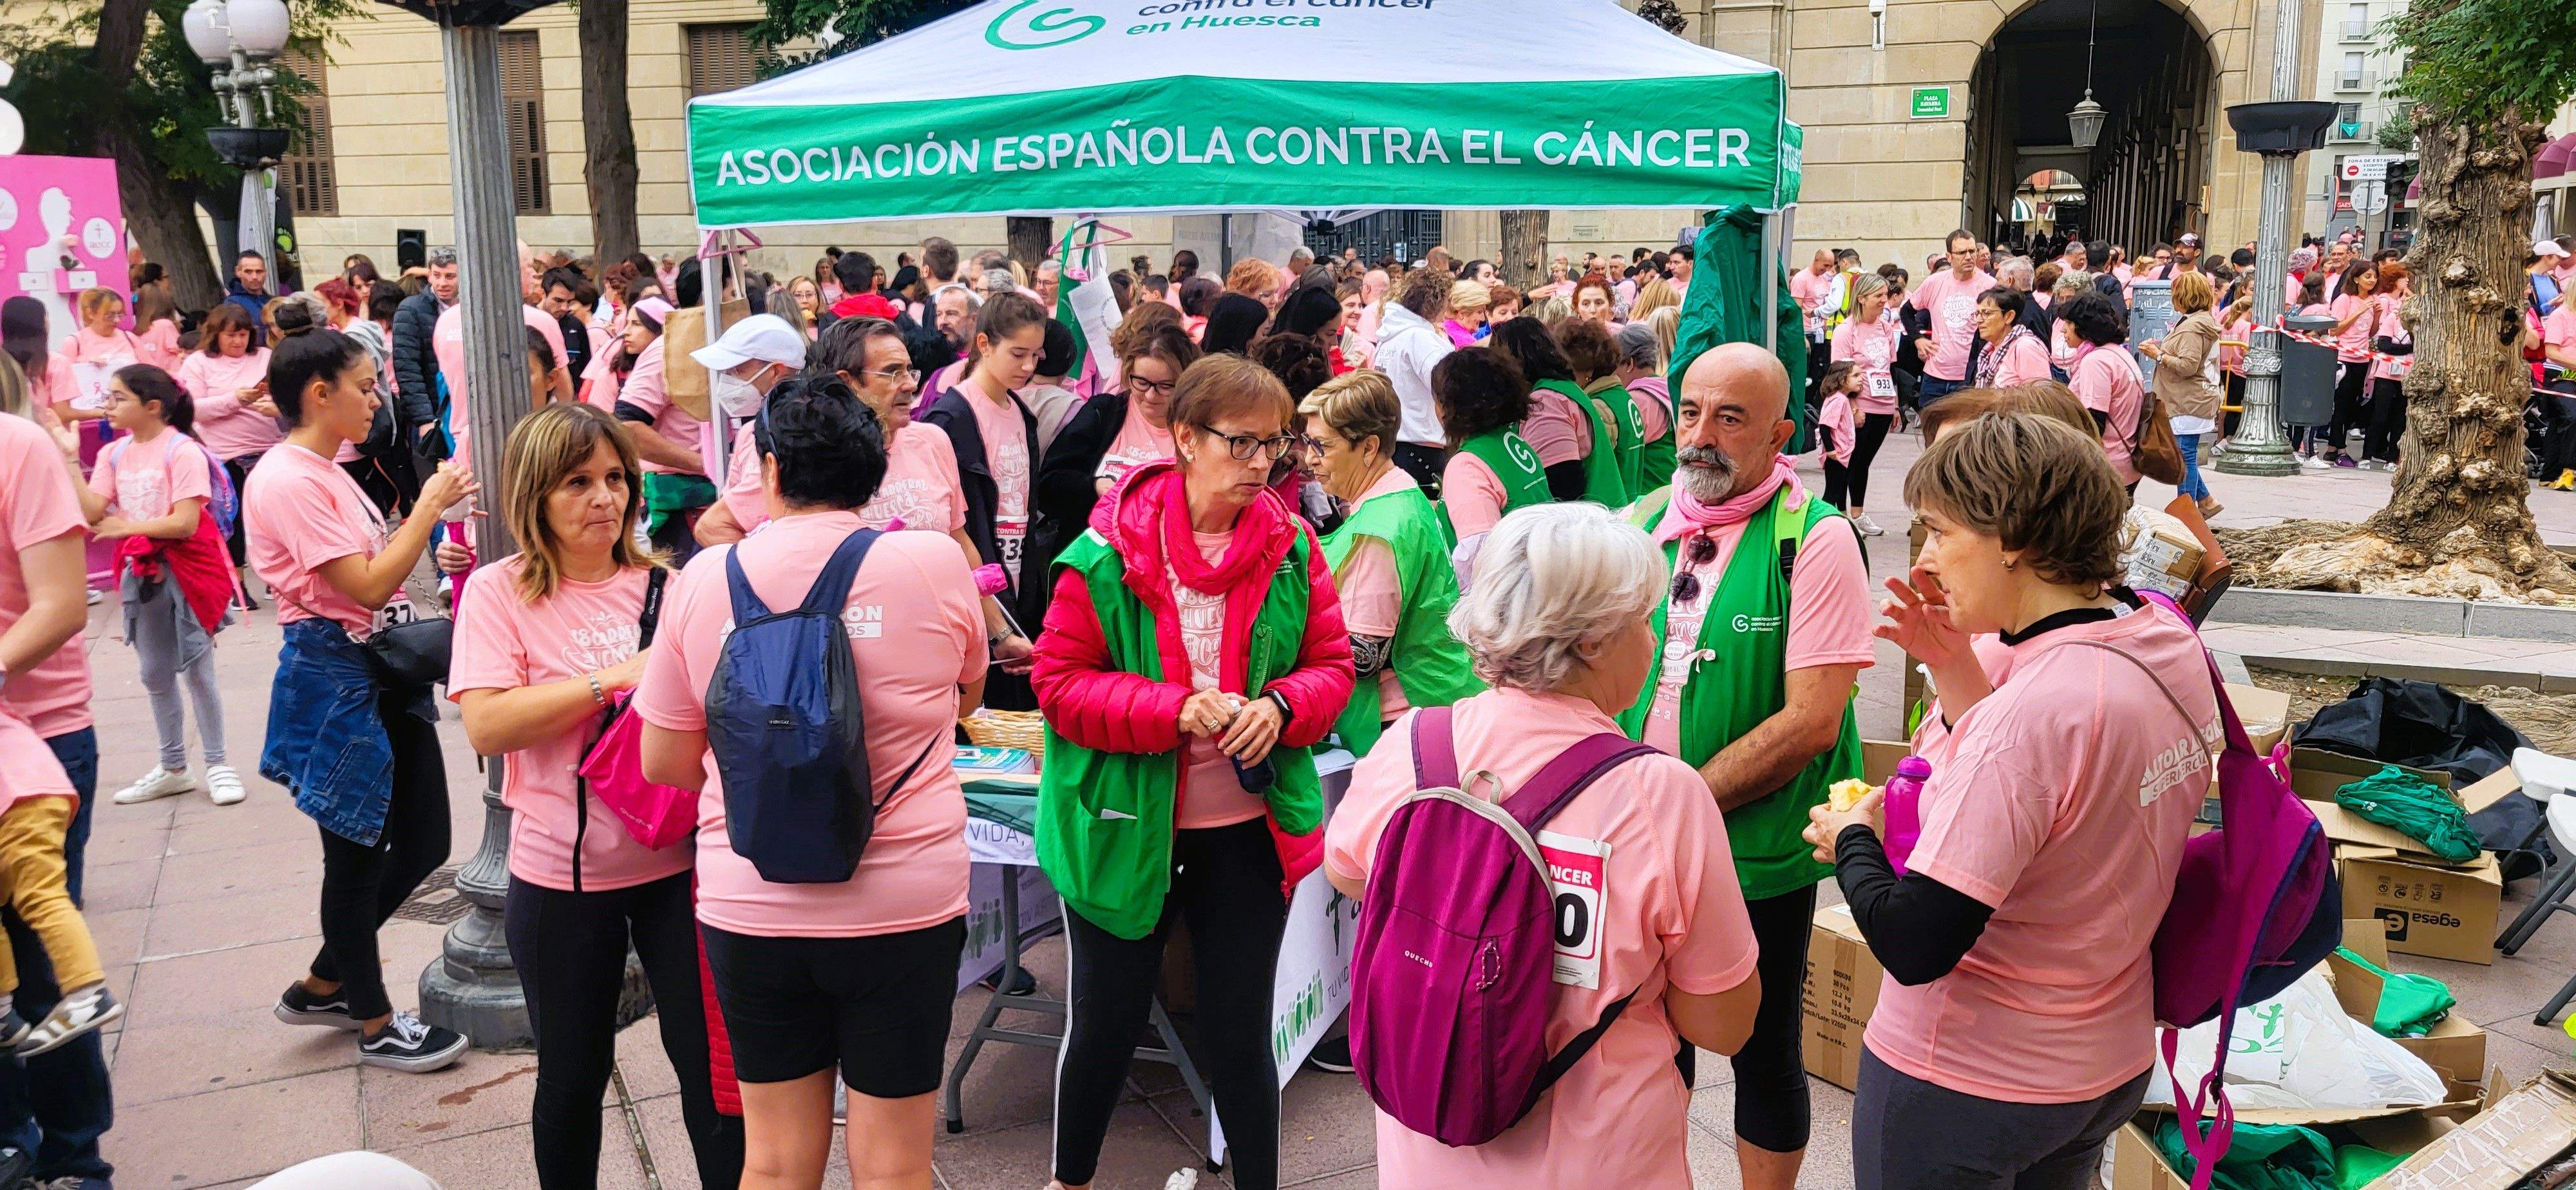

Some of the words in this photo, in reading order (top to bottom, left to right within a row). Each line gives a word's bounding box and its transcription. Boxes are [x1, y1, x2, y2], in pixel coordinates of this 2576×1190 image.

[1126, 21, 1171, 35] en
[1180, 15, 1321, 30] Huesca
[717, 131, 980, 187] ASOCIACIÓN
[992, 119, 1235, 172] ESPAÑOLA
[1245, 126, 1450, 165] CONTRA
[1463, 129, 1522, 164] EL
[1533, 120, 1752, 167] CÁNCER
[1876, 379, 1891, 390] 933
[969, 823, 1025, 847] VIDA,
[1549, 864, 1593, 887] NCER
[2412, 912, 2461, 928] egesa
[1844, 994, 1852, 1004] kg
[1844, 1004, 1851, 1014] kg
